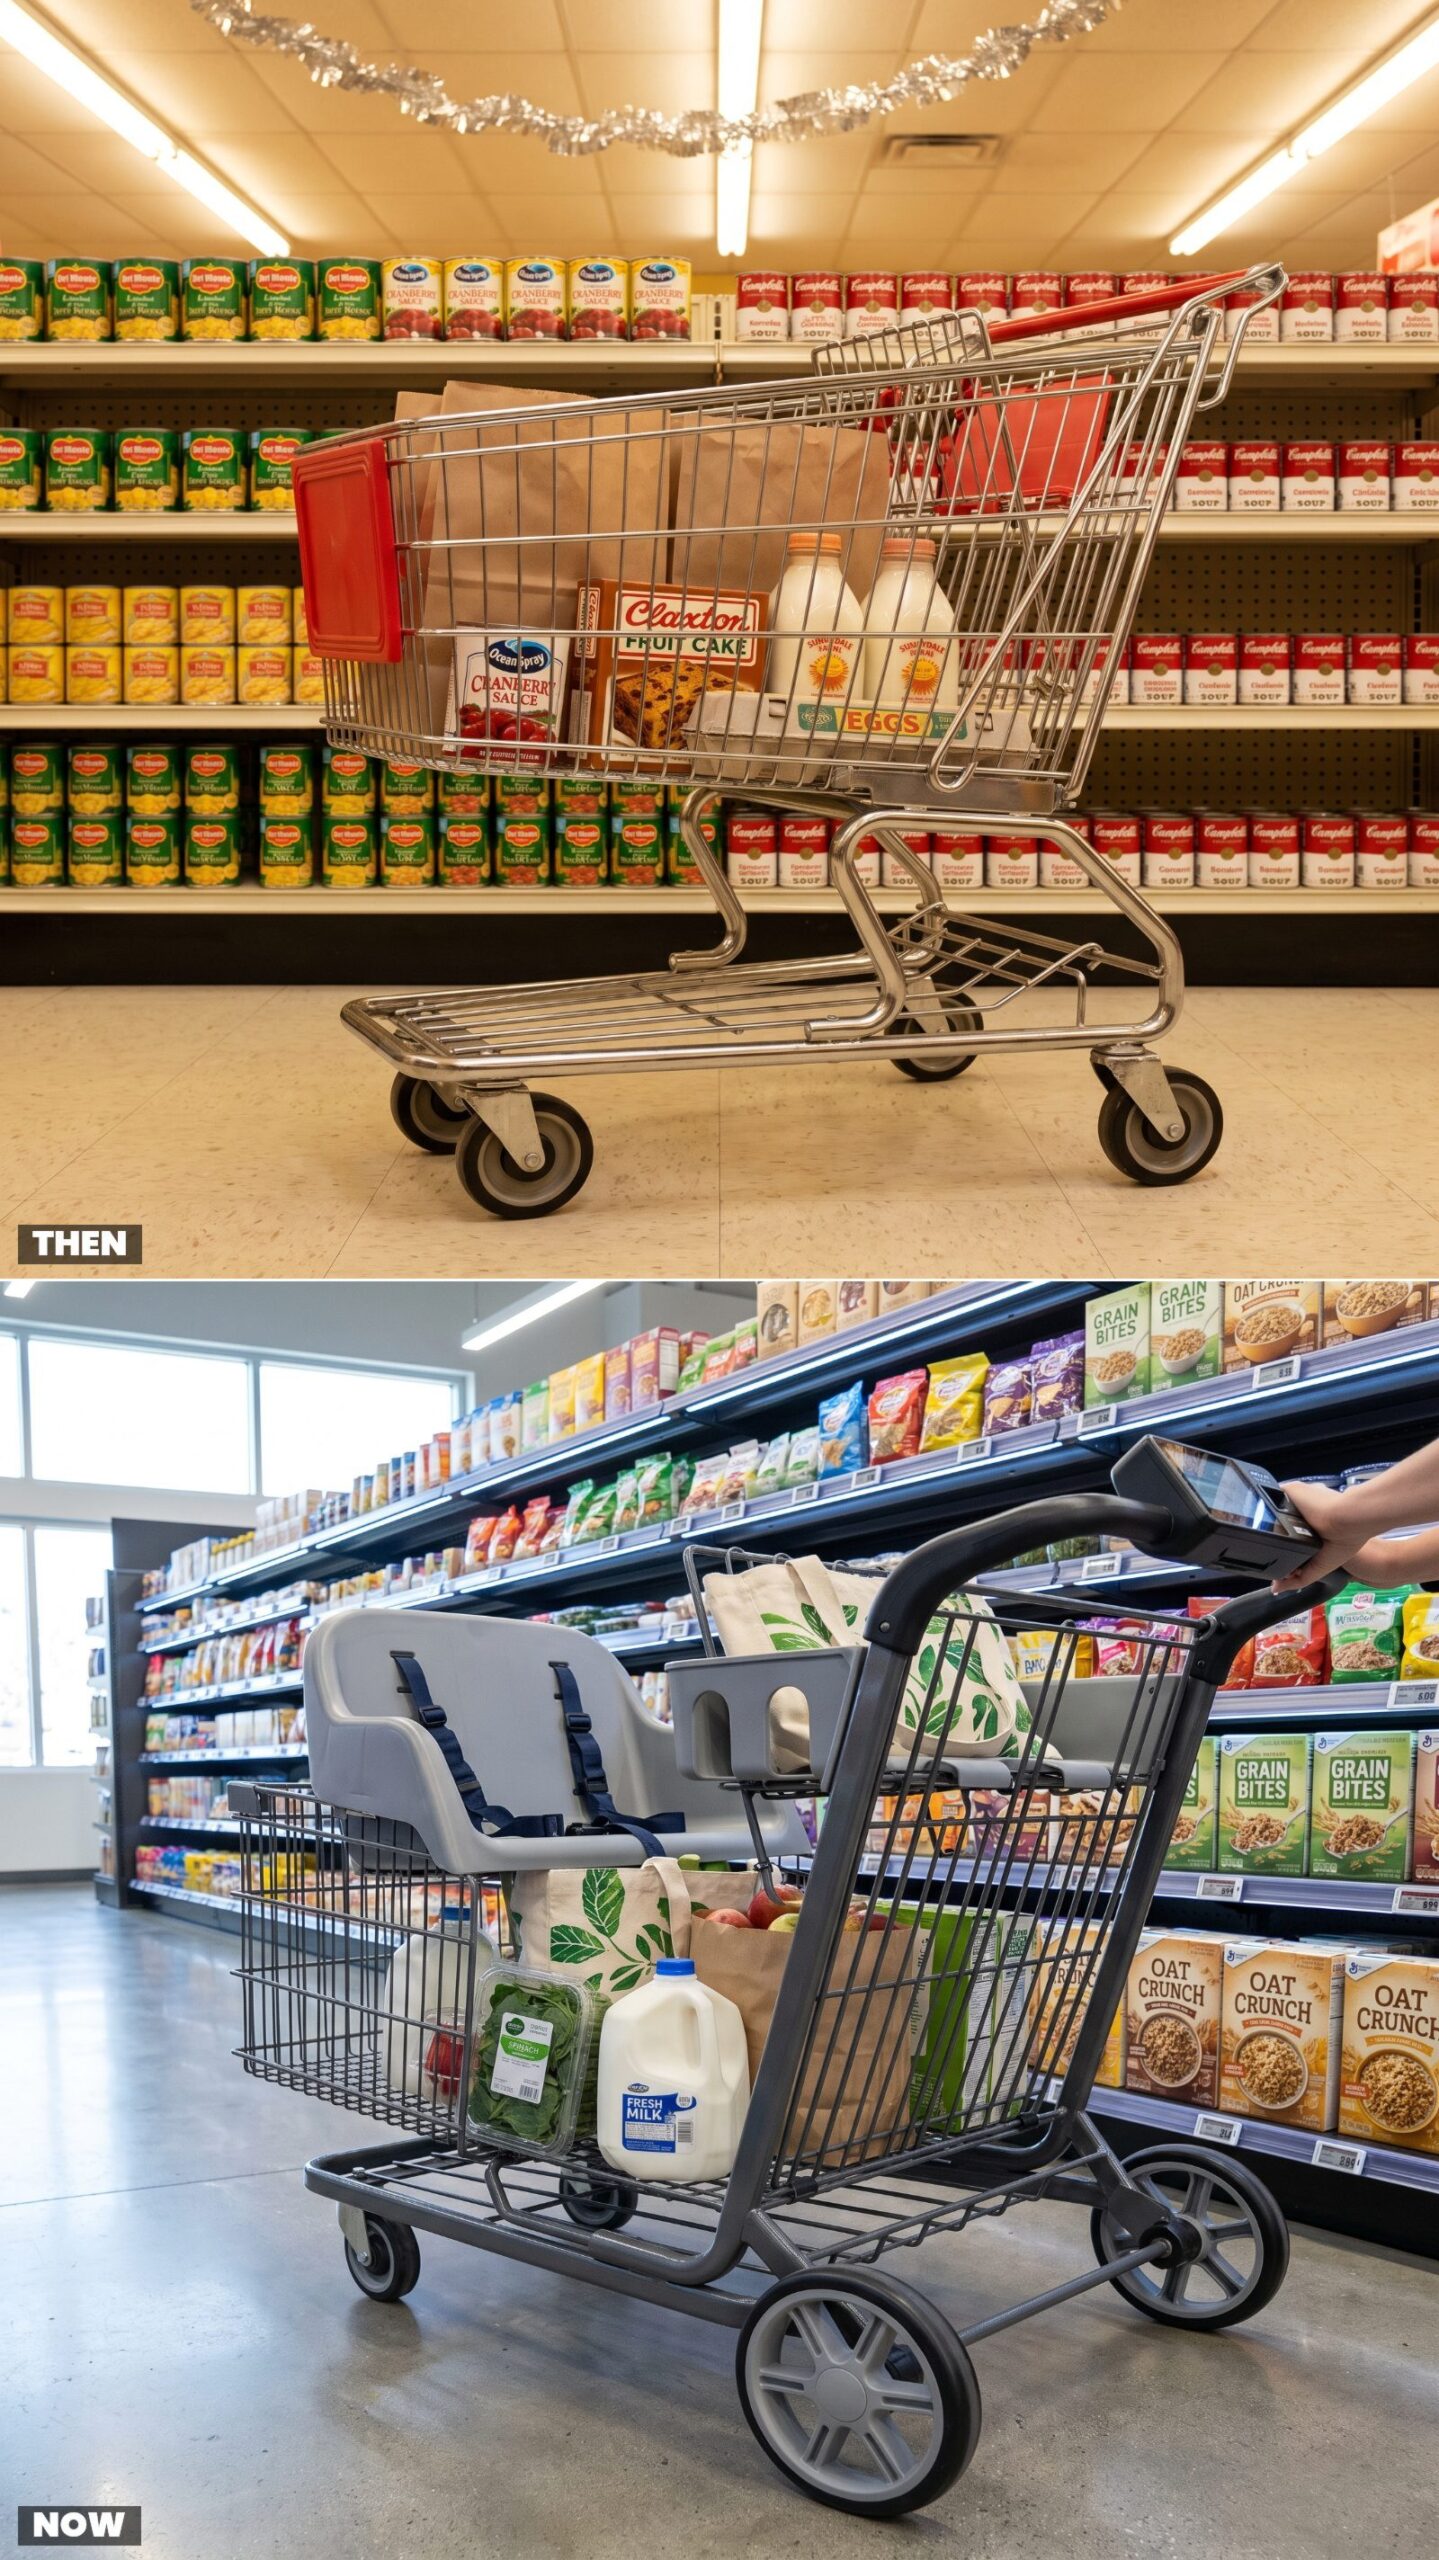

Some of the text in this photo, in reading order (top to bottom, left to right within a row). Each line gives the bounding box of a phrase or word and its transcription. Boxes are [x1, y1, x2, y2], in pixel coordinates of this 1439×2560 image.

[386, 289, 436, 299] CRANBERRY
[448, 289, 498, 299] CRANBERRY
[512, 289, 562, 299] CRANBERRY
[572, 289, 622, 299] CRANBERRY
[634, 289, 684, 299] CRANBERRY
[1296, 330, 1325, 338] SOUP
[1353, 330, 1382, 338] SOUP
[1404, 330, 1433, 338] SOUP
[625, 600, 751, 632] Claxton
[490, 648, 518, 667] Ocean
[847, 711, 920, 734] EGGS
[1160, 1281, 1207, 1307] GRAIN
[1094, 1302, 1139, 1330] GRAIN
[1162, 1295, 1206, 1324] BITES
[1096, 1320, 1137, 1346] BITES
[1236, 1760, 1288, 1780] GRAIN
[1331, 1759, 1389, 1779] GRAIN
[1238, 1780, 1287, 1800] BITES
[1332, 1780, 1386, 1800] BITES
[1151, 1958, 1191, 1981] OAT
[1138, 1977, 1205, 2006] CRUNCH
[1250, 1972, 1296, 1996] OAT
[1234, 1992, 1312, 2024] CRUNCH
[1374, 1985, 1428, 2012] OAT
[627, 2097, 663, 2110] FRESH
[626, 2108, 662, 2120] MILK
